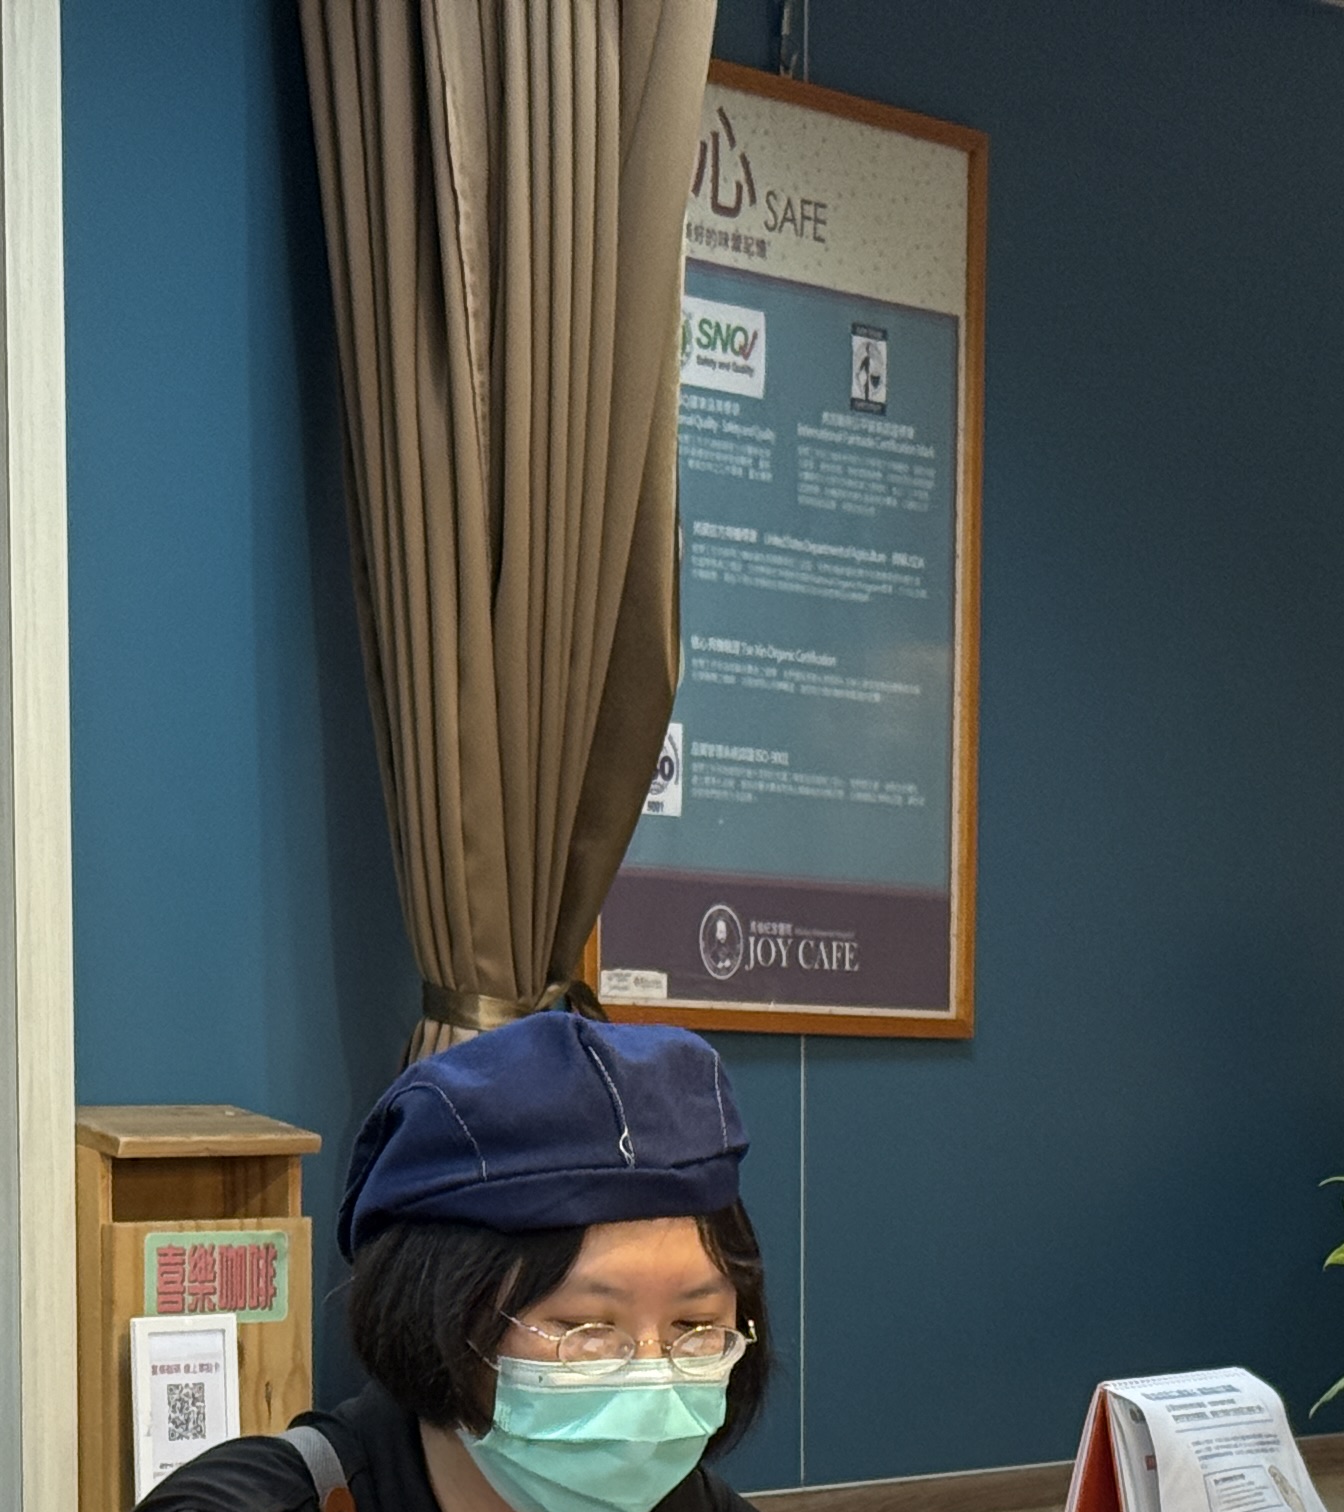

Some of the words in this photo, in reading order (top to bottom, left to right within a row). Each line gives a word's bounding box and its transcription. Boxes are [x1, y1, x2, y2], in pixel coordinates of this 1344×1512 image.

[763, 190, 828, 244] SAFE
[744, 936, 794, 972] JOY
[798, 938, 859, 972] CAFE
